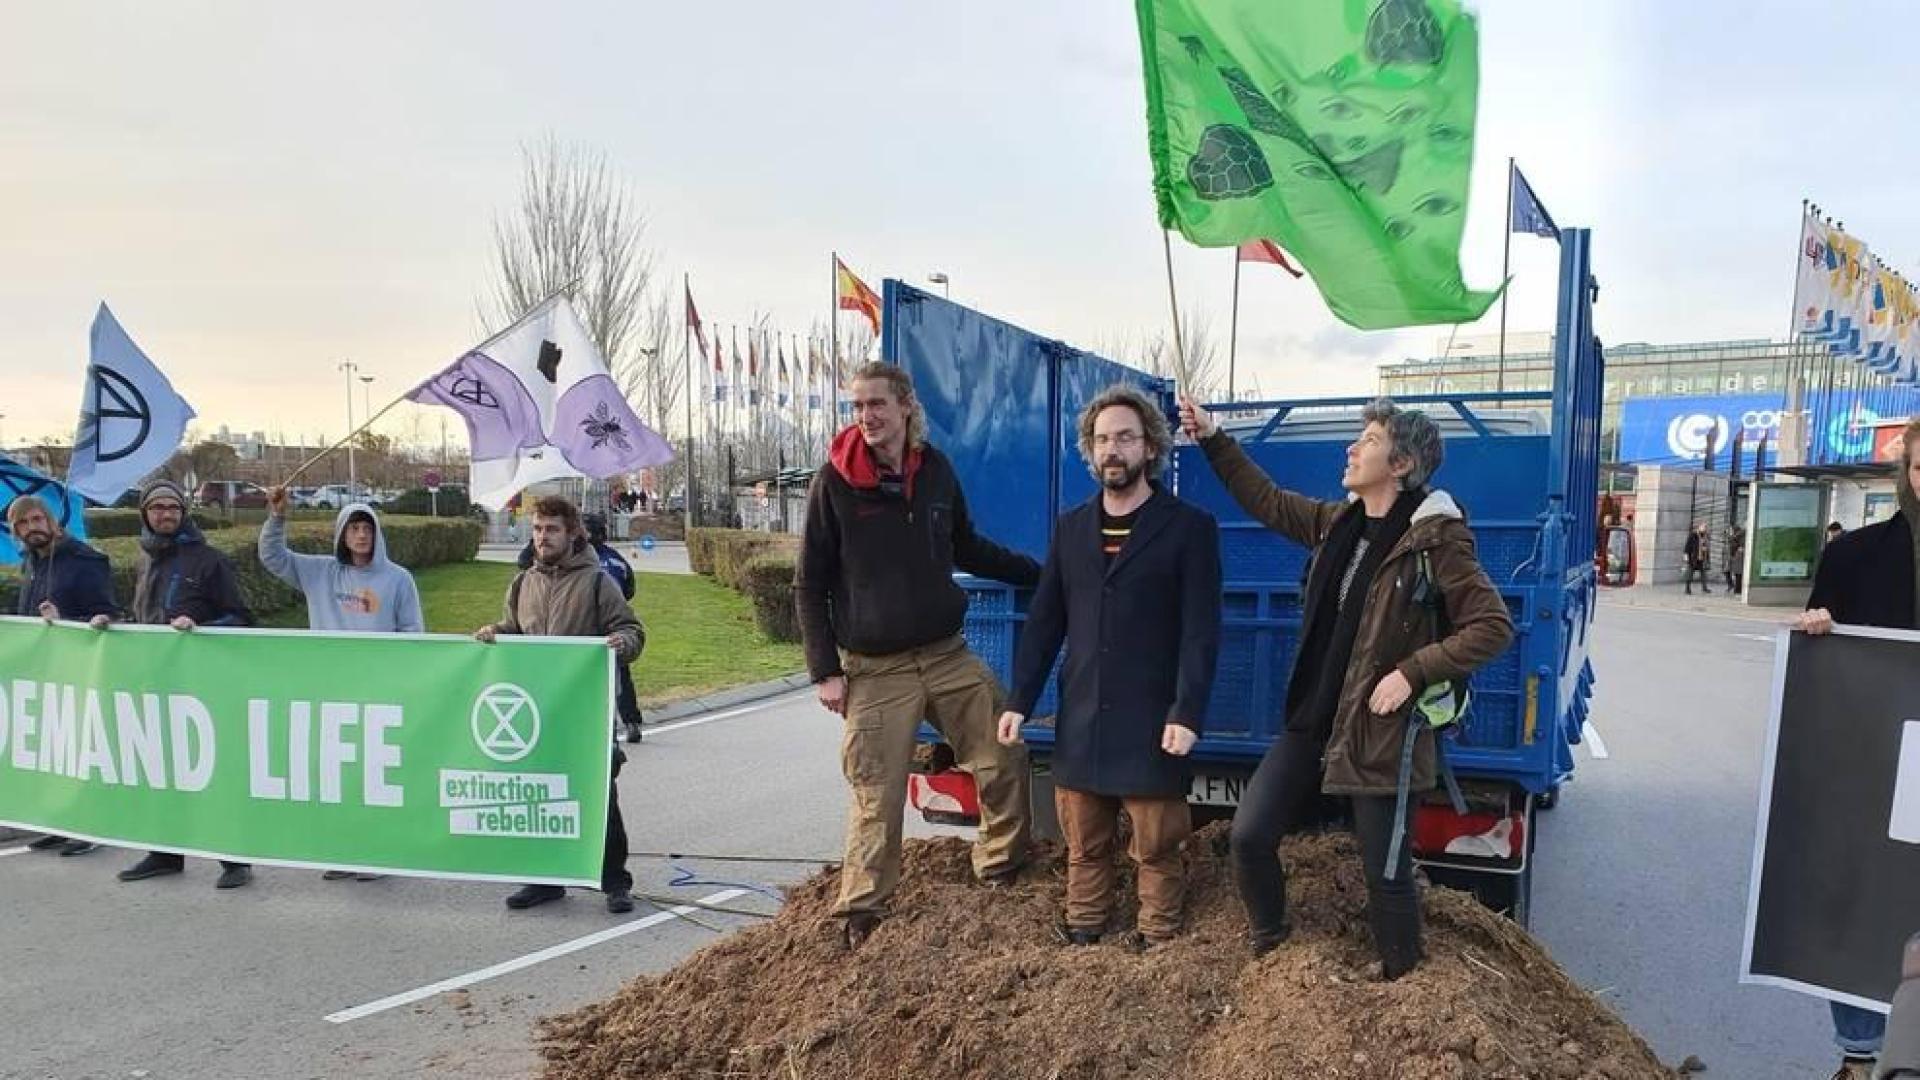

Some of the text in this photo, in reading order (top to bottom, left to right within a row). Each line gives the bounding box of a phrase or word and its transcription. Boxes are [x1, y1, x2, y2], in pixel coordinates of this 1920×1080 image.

[0, 680, 404, 807] EMAND LIFE
[445, 774, 550, 801] extinction
[1195, 777, 1249, 801] FN
[476, 803, 575, 834] rebellion
